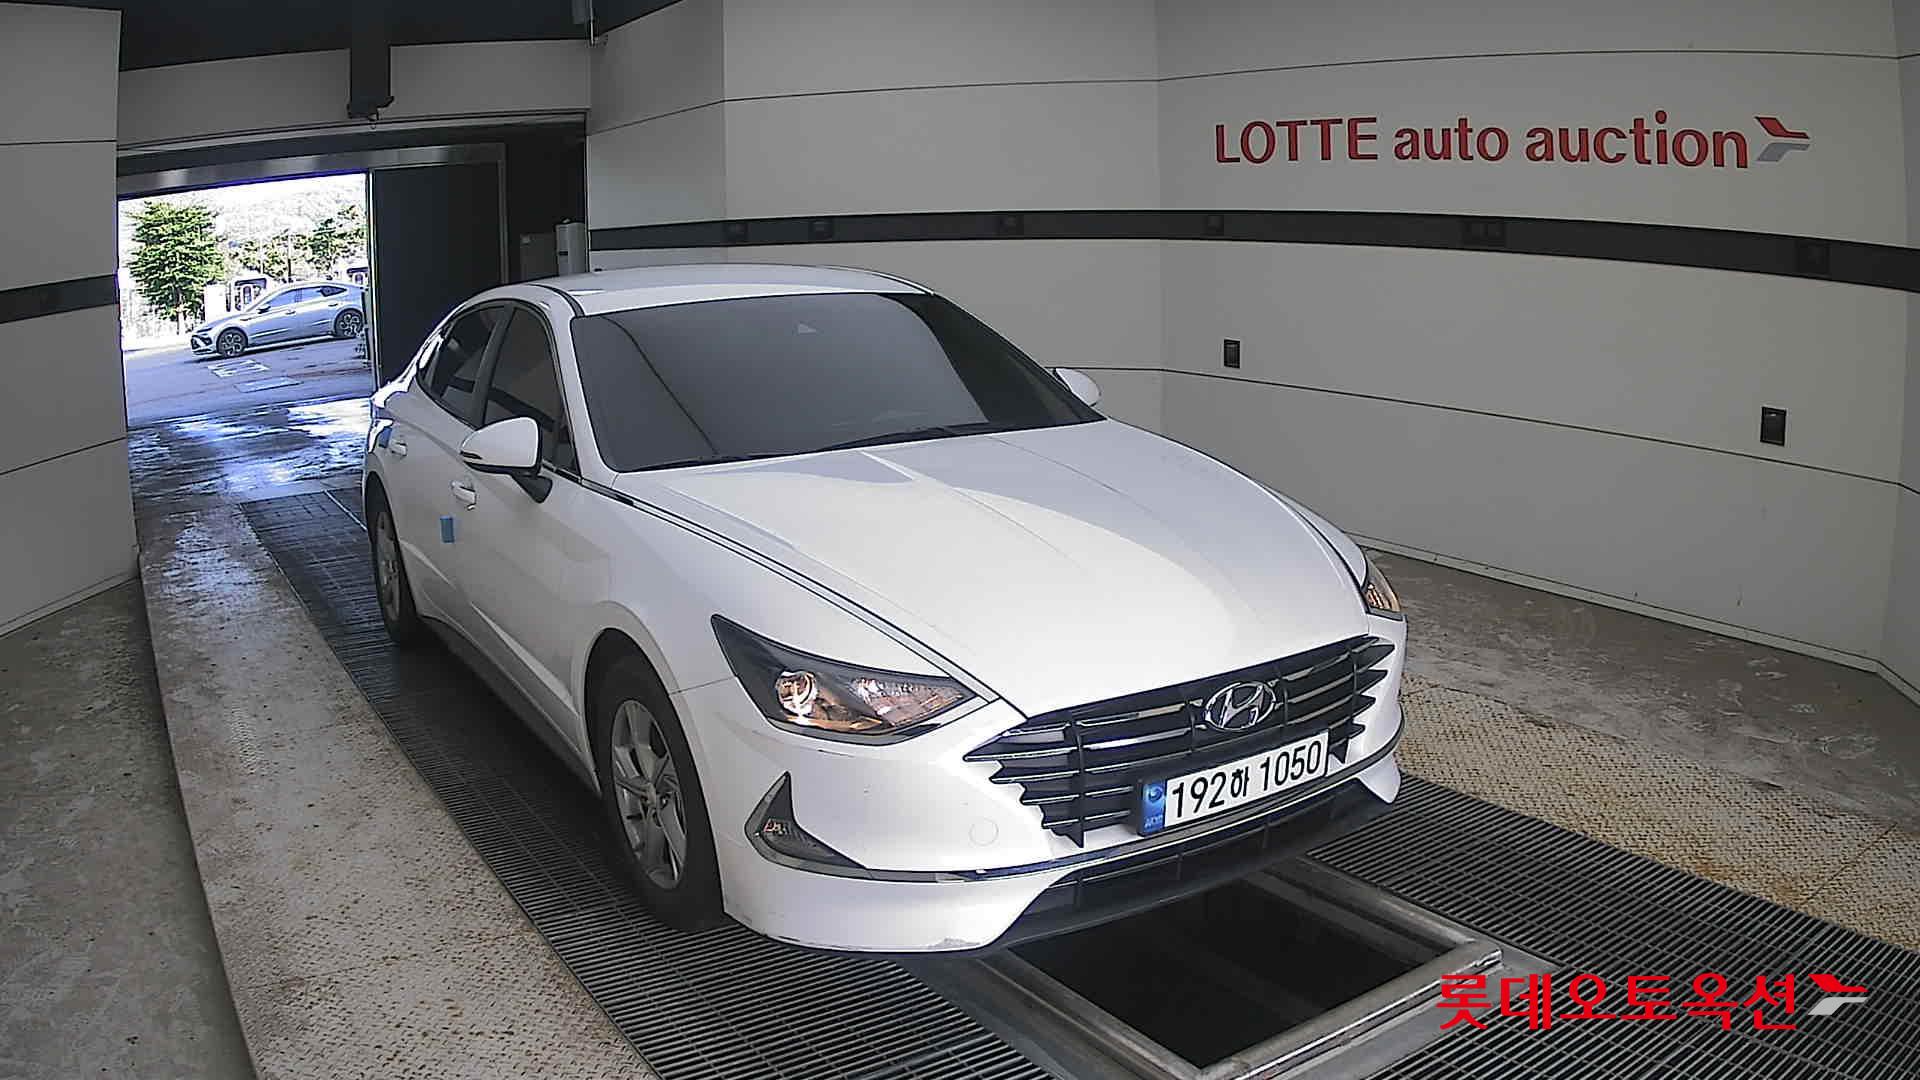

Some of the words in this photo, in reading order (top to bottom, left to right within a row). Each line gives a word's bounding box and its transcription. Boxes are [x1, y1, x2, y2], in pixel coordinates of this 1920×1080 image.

[1215, 117, 1377, 164] LOTTE
[1394, 118, 1508, 161] auto
[1525, 110, 1747, 169] auction
[1171, 767, 1249, 818] 192하
[1260, 740, 1321, 791] 1050
